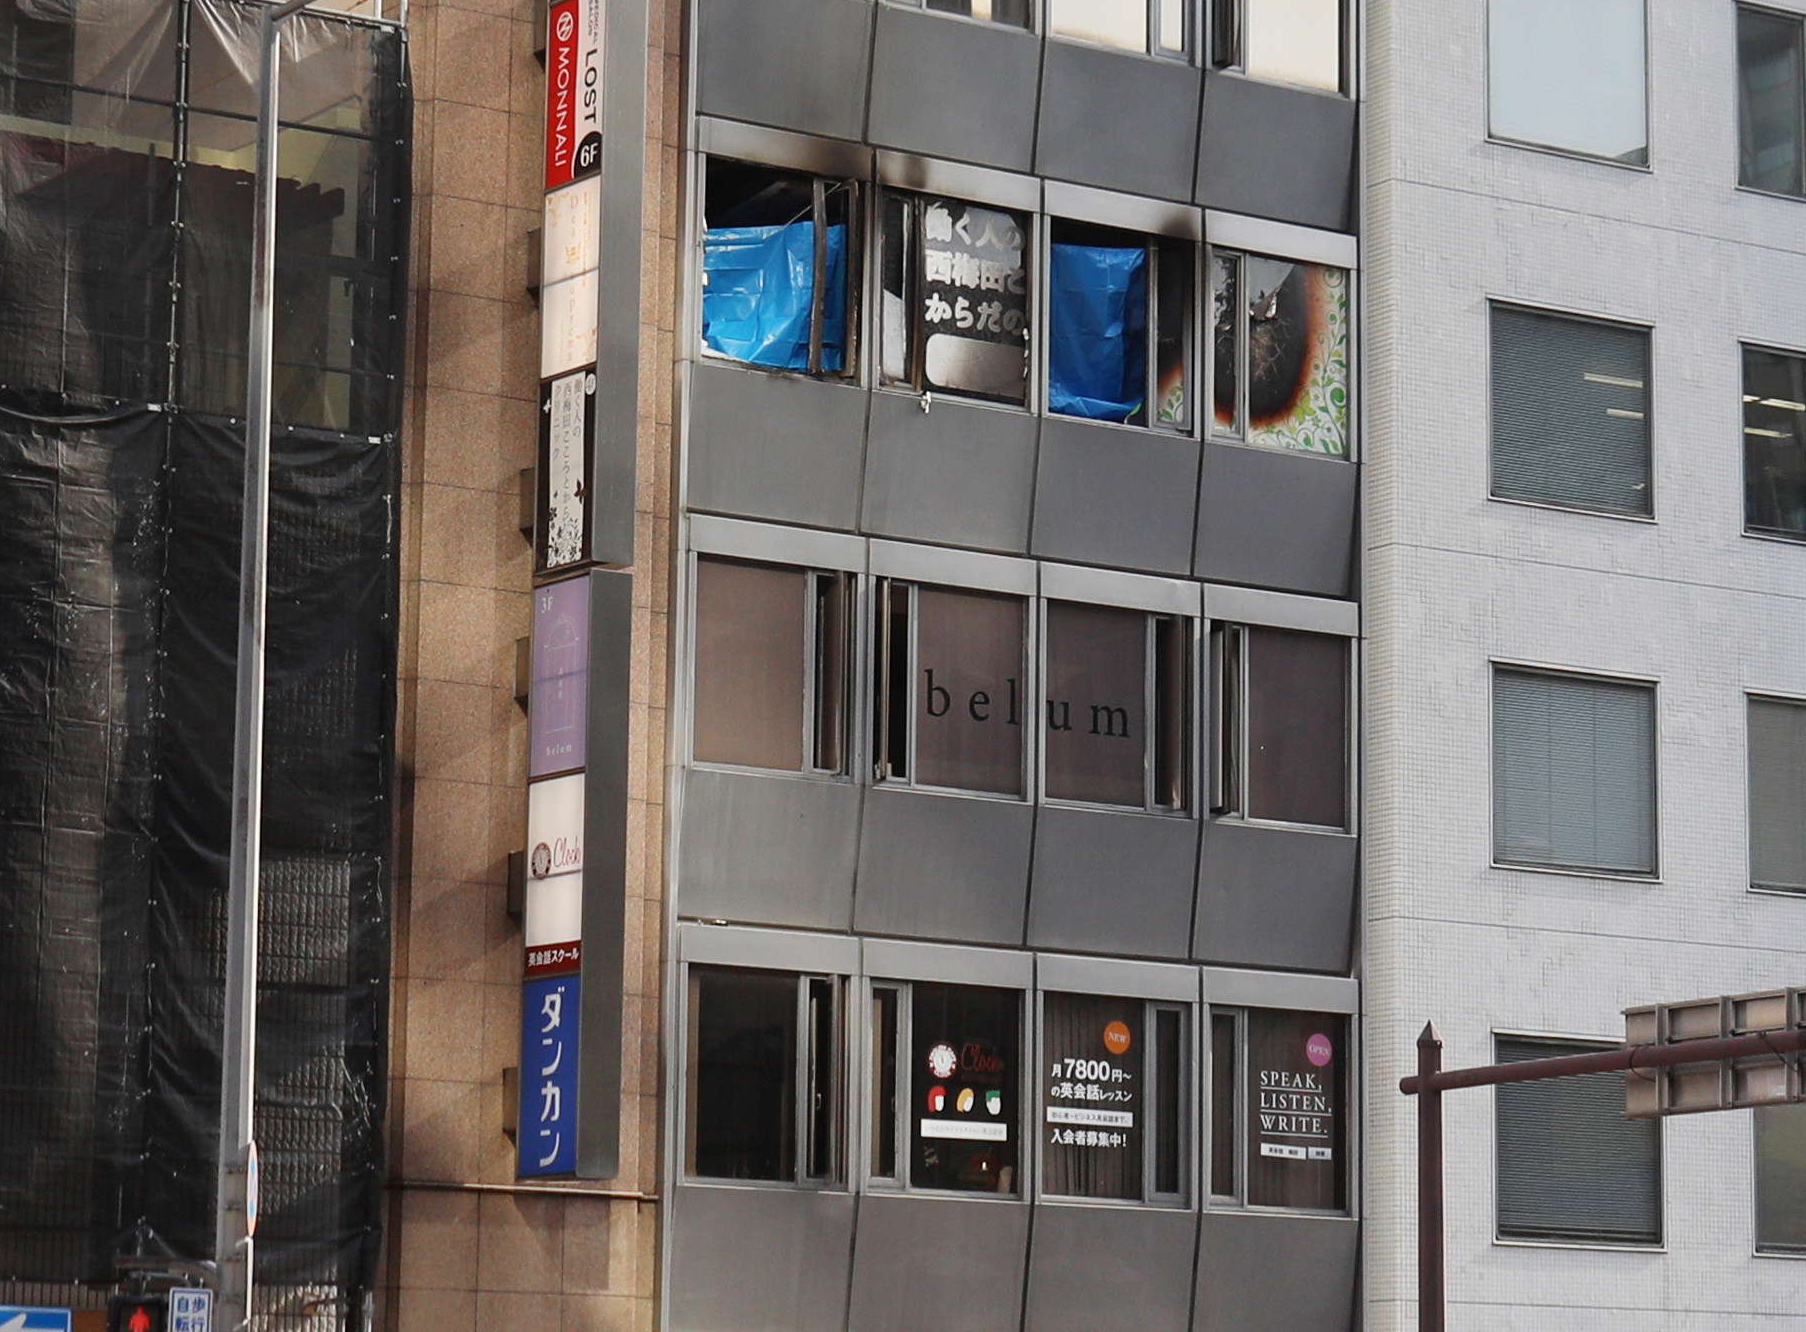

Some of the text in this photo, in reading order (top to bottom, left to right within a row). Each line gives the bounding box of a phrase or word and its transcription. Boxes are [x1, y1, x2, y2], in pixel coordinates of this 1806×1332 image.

[584, 49, 598, 124] LOST
[554, 47, 570, 167] MONNALI
[580, 143, 598, 167] 6F
[925, 292, 1025, 336] からだの
[541, 596, 554, 614] 3F
[924, 668, 1132, 739] belum
[553, 836, 582, 869] Clock
[527, 946, 580, 968] 英会話スクール
[539, 986, 567, 1168] ダンカン
[1259, 1070, 1323, 1091] SPEAK,
[1050, 1081, 1133, 1103] の英会話レッスン
[1259, 1092, 1333, 1113] LISTEN,
[1259, 1114, 1328, 1134] WRITE.
